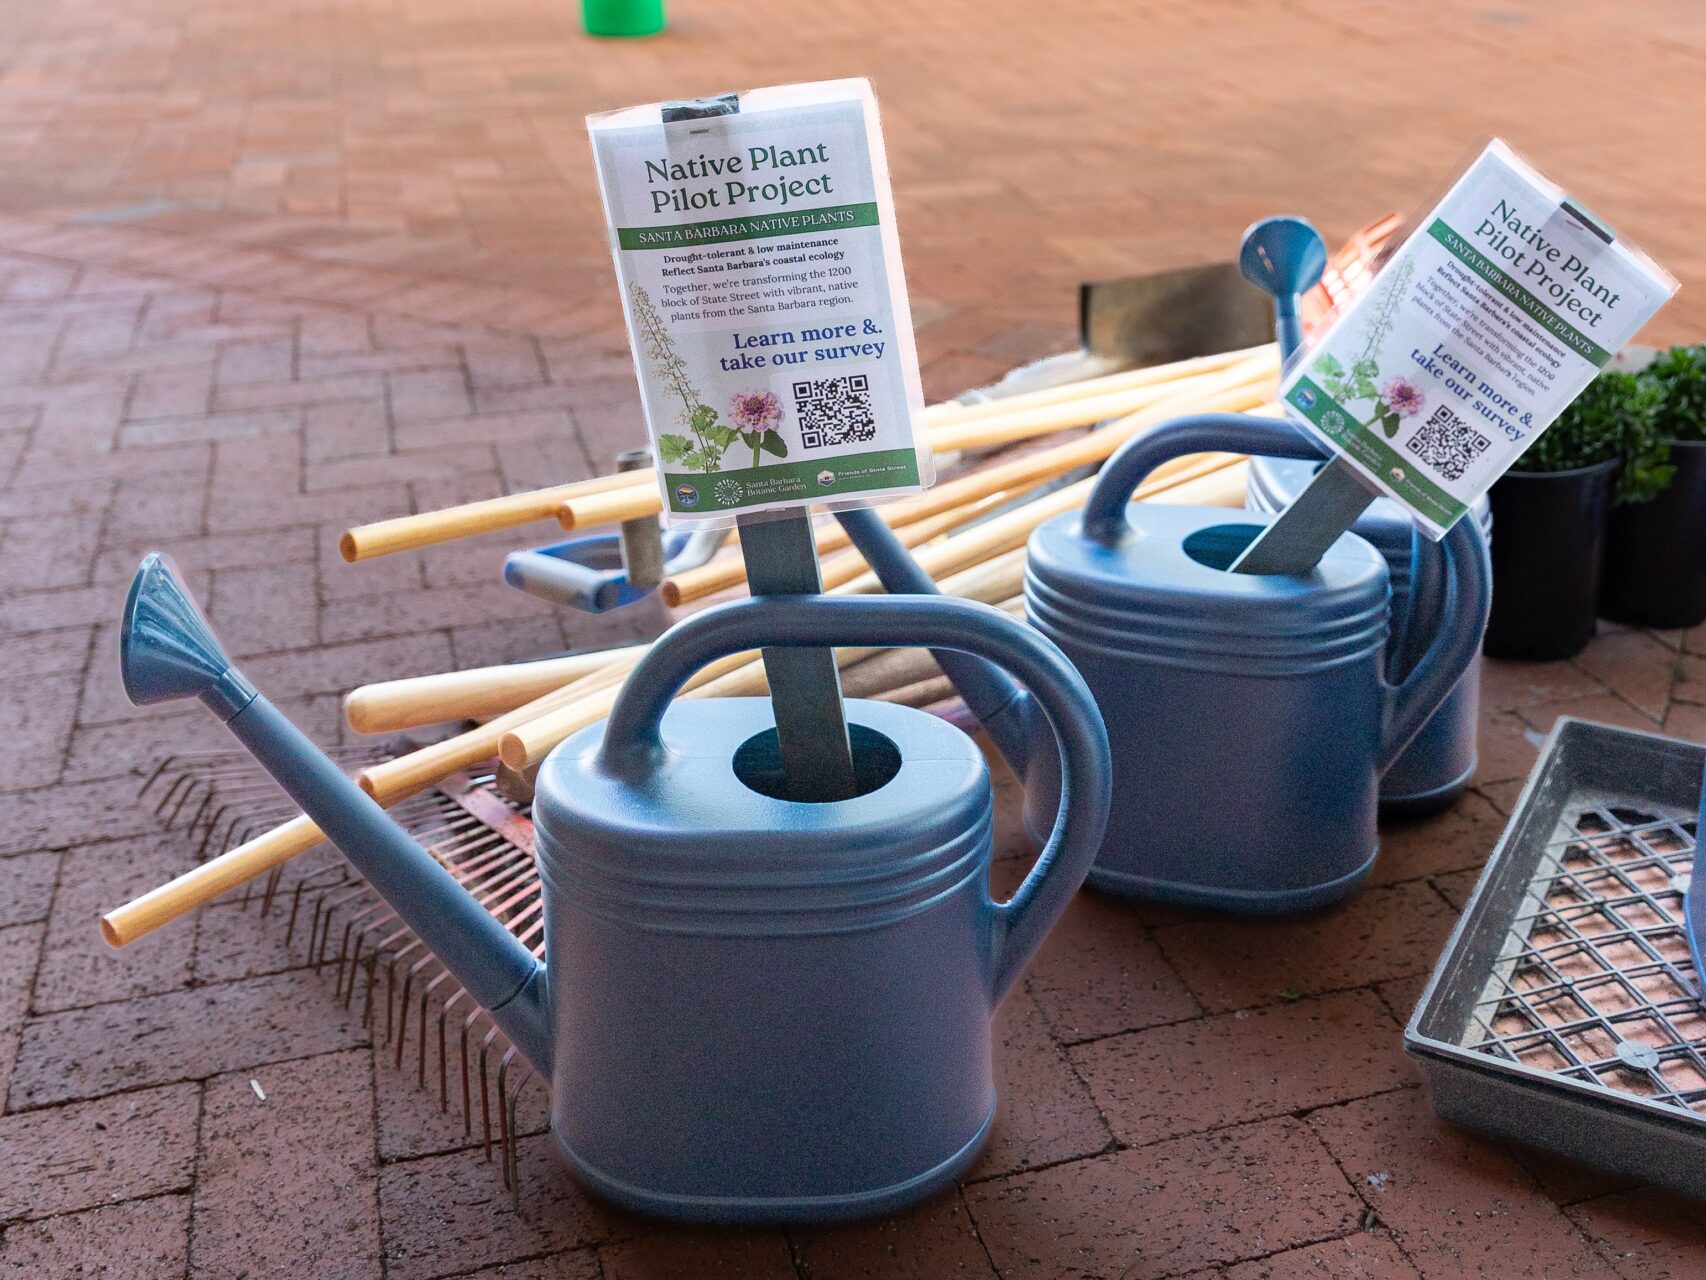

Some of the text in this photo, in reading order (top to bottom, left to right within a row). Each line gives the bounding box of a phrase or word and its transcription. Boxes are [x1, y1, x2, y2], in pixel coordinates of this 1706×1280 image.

[644, 143, 829, 183] Native Plant
[650, 174, 833, 213] Pilot Project
[638, 210, 854, 243] SANTA BARBARA NATIVE PLANTS
[661, 251, 845, 277] Reflect Santa Barbara's coastal ecology
[663, 238, 838, 263] Drought-tolerant & low maintenance
[1491, 199, 1620, 309] Native Plant
[662, 265, 852, 295] Together, we're transforming the 1200
[1474, 218, 1602, 327] Pilot Project
[660, 280, 858, 307] block of State Street with vibrant, native
[1444, 233, 1594, 354] SANTA BARBARA NATIVE PLANTS
[670, 295, 853, 323] plants from the Santa Barbara region.
[732, 331, 795, 349] Learn
[800, 324, 856, 342] more
[719, 342, 885, 371] take our survey
[1432, 343, 1476, 384] Learn
[1477, 381, 1518, 415] more
[1411, 349, 1525, 442] take our survey
[745, 477, 801, 489] Santa Barbara
[747, 483, 807, 496] Botanic Garden
